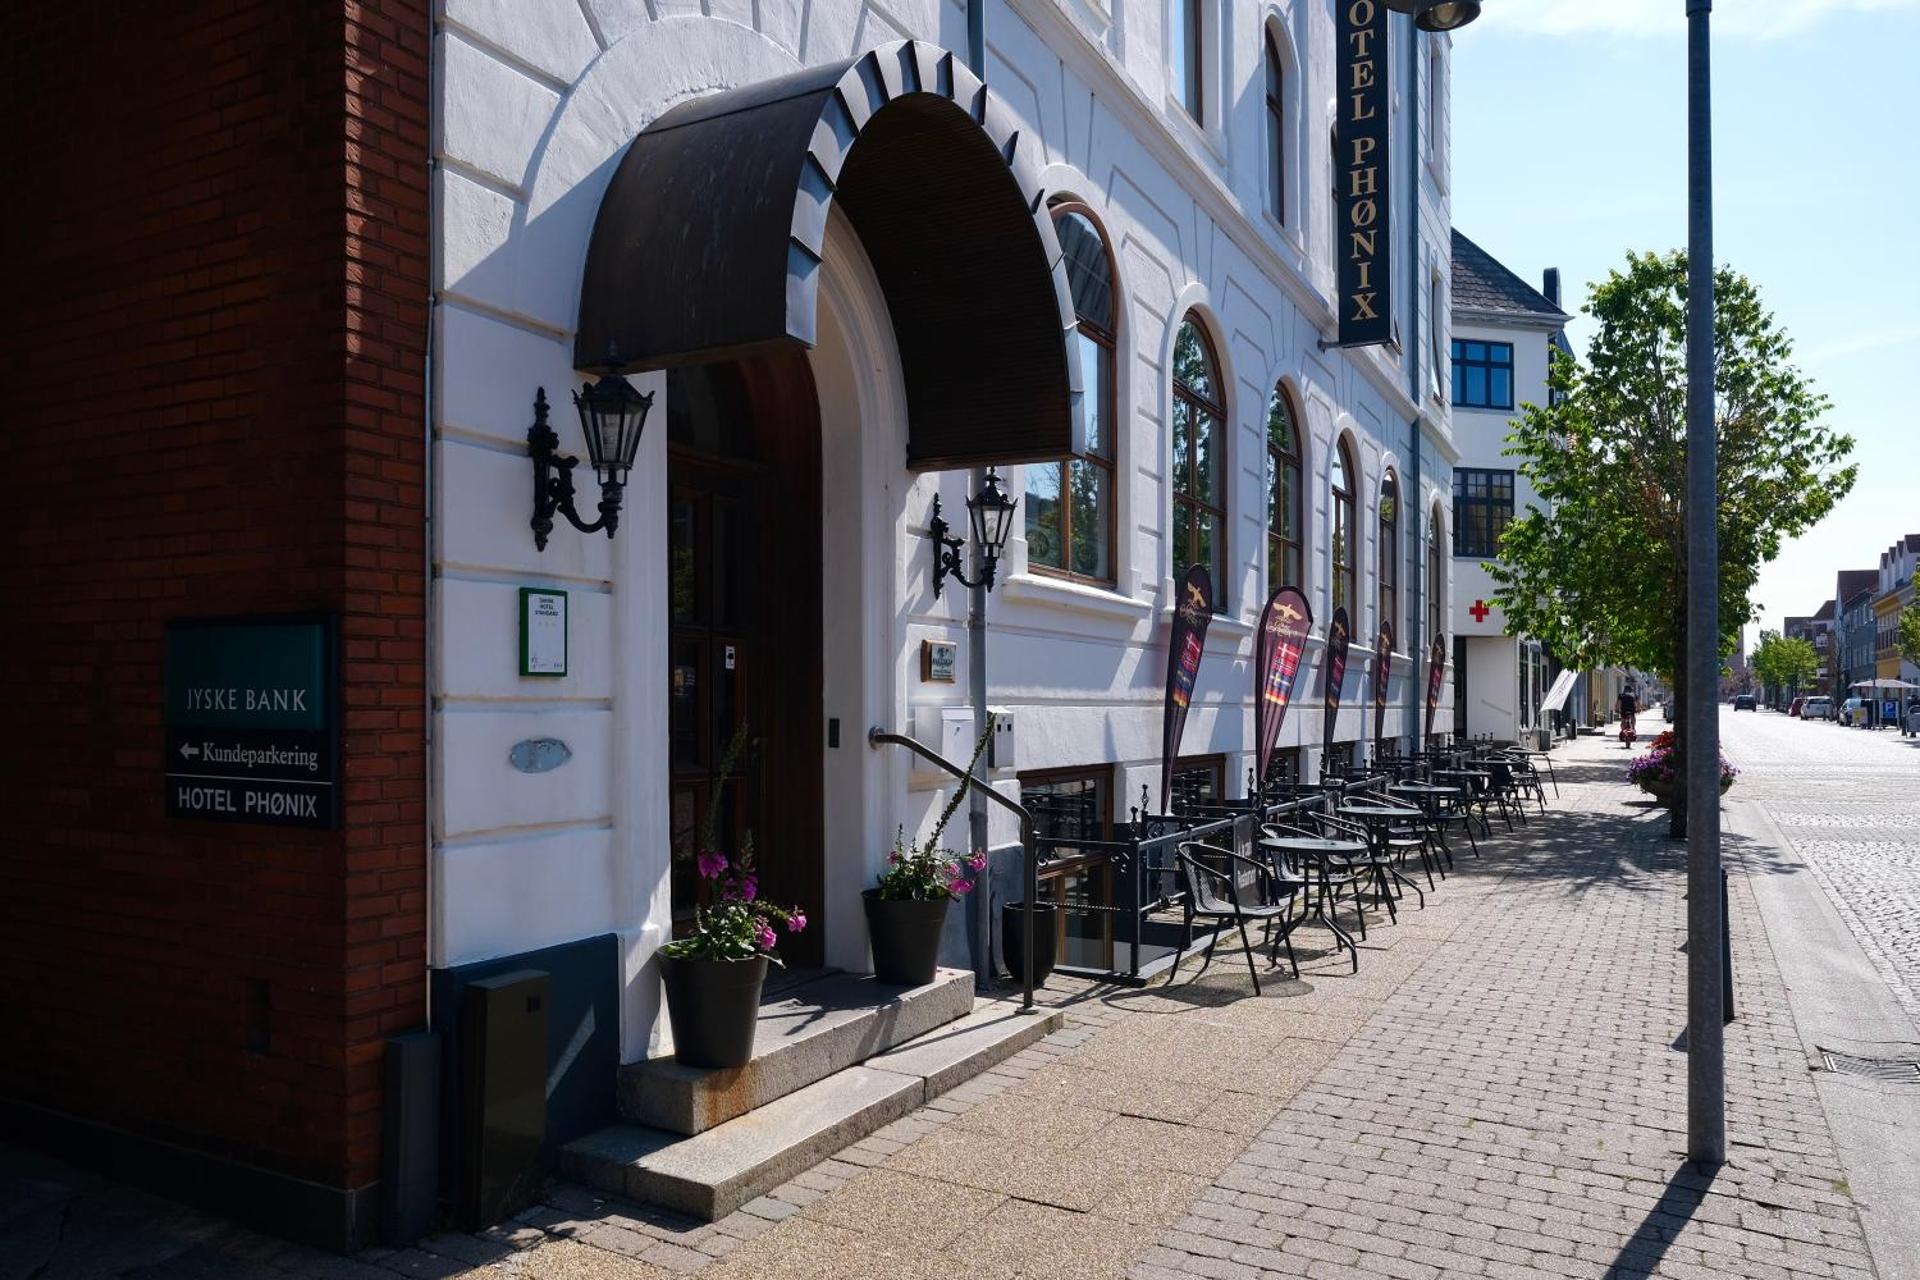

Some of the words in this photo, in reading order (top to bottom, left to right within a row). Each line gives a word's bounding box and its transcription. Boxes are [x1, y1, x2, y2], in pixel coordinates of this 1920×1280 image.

[1349, 0, 1376, 120] OTEL
[1350, 137, 1379, 321] PHØNIX
[187, 688, 237, 710] JYSKE
[246, 689, 307, 711] BANK
[202, 742, 318, 771] Kundeparkering
[178, 787, 237, 812] HOTEL
[245, 791, 318, 818] PHØNIX
